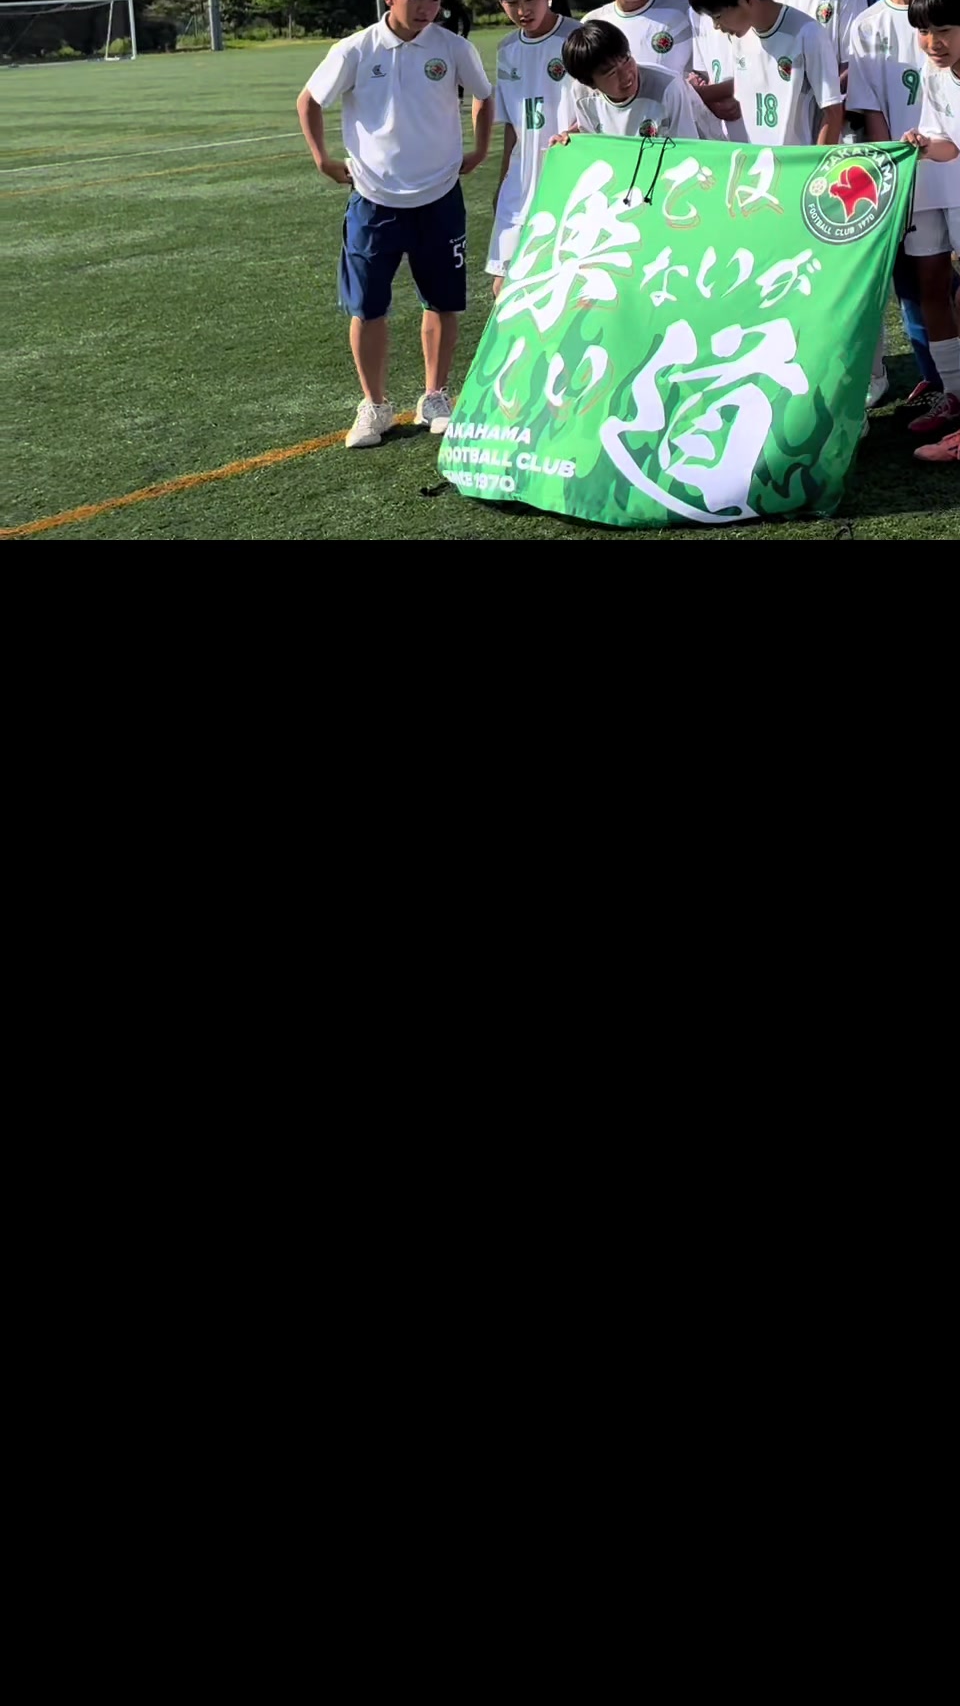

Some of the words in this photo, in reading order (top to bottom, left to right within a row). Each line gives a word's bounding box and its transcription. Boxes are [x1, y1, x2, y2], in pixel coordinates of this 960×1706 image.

[902, 69, 920, 106] 9
[525, 96, 545, 130] 15
[756, 92, 778, 128] 18
[662, 148, 782, 221] では
[821, 147, 892, 195] TAKAHAMA
[808, 203, 832, 235] FOOTBALL
[835, 227, 855, 236] CLUB
[858, 213, 875, 229] 1970
[453, 239, 467, 269] 5
[640, 246, 821, 308] ないが
[445, 422, 531, 445] AKAHAMA
[600, 318, 809, 523] 道
[516, 452, 576, 478] CLUB
